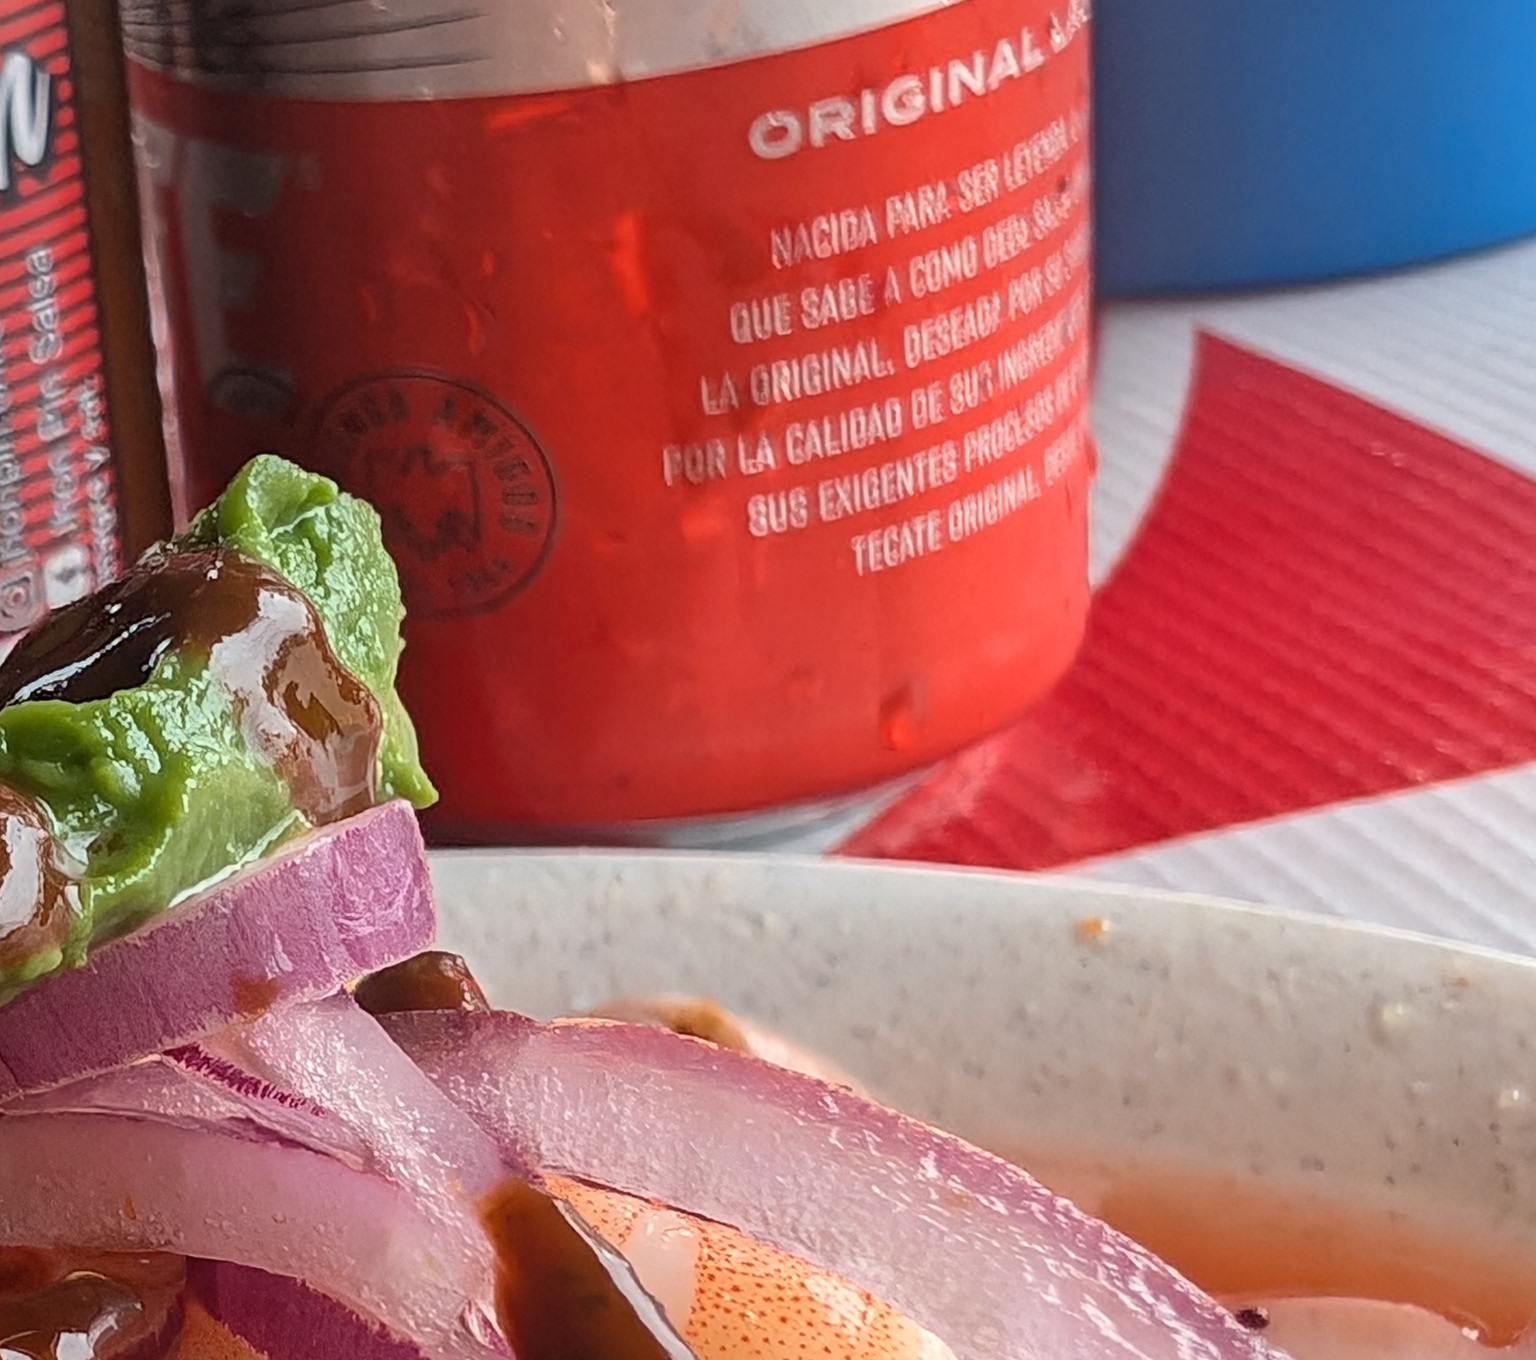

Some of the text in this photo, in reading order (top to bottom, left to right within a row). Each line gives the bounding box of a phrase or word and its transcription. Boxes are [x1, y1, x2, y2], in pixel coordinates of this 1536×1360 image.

[748, 26, 1046, 160] ORIGINAL
[770, 205, 878, 270] NACIDA
[885, 180, 952, 240] PARA
[729, 293, 793, 345] QUE
[799, 271, 876, 331] SABE
[884, 266, 903, 307] A
[908, 234, 978, 300] COMO
[663, 439, 727, 487] POR
[737, 431, 778, 476] LA
[784, 396, 903, 466] CALIDAD
[911, 381, 946, 431] DE
[700, 371, 739, 416] LA
[746, 486, 809, 538] SUS
[817, 440, 959, 524] EXIGENTES
[850, 510, 946, 577] TECATE
